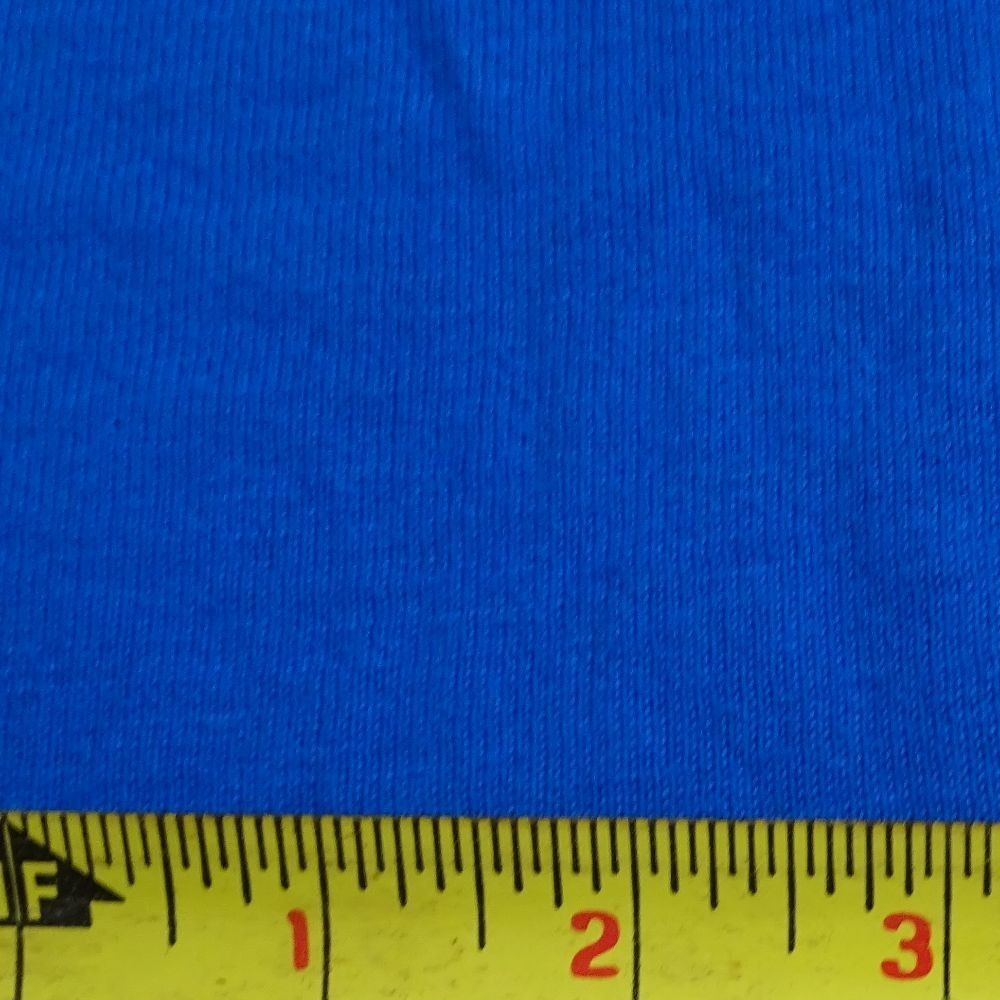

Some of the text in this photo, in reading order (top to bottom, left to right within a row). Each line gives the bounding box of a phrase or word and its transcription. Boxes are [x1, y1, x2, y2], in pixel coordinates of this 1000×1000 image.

[288, 909, 309, 970] 1
[570, 911, 620, 978] 2
[880, 913, 934, 980] 3
